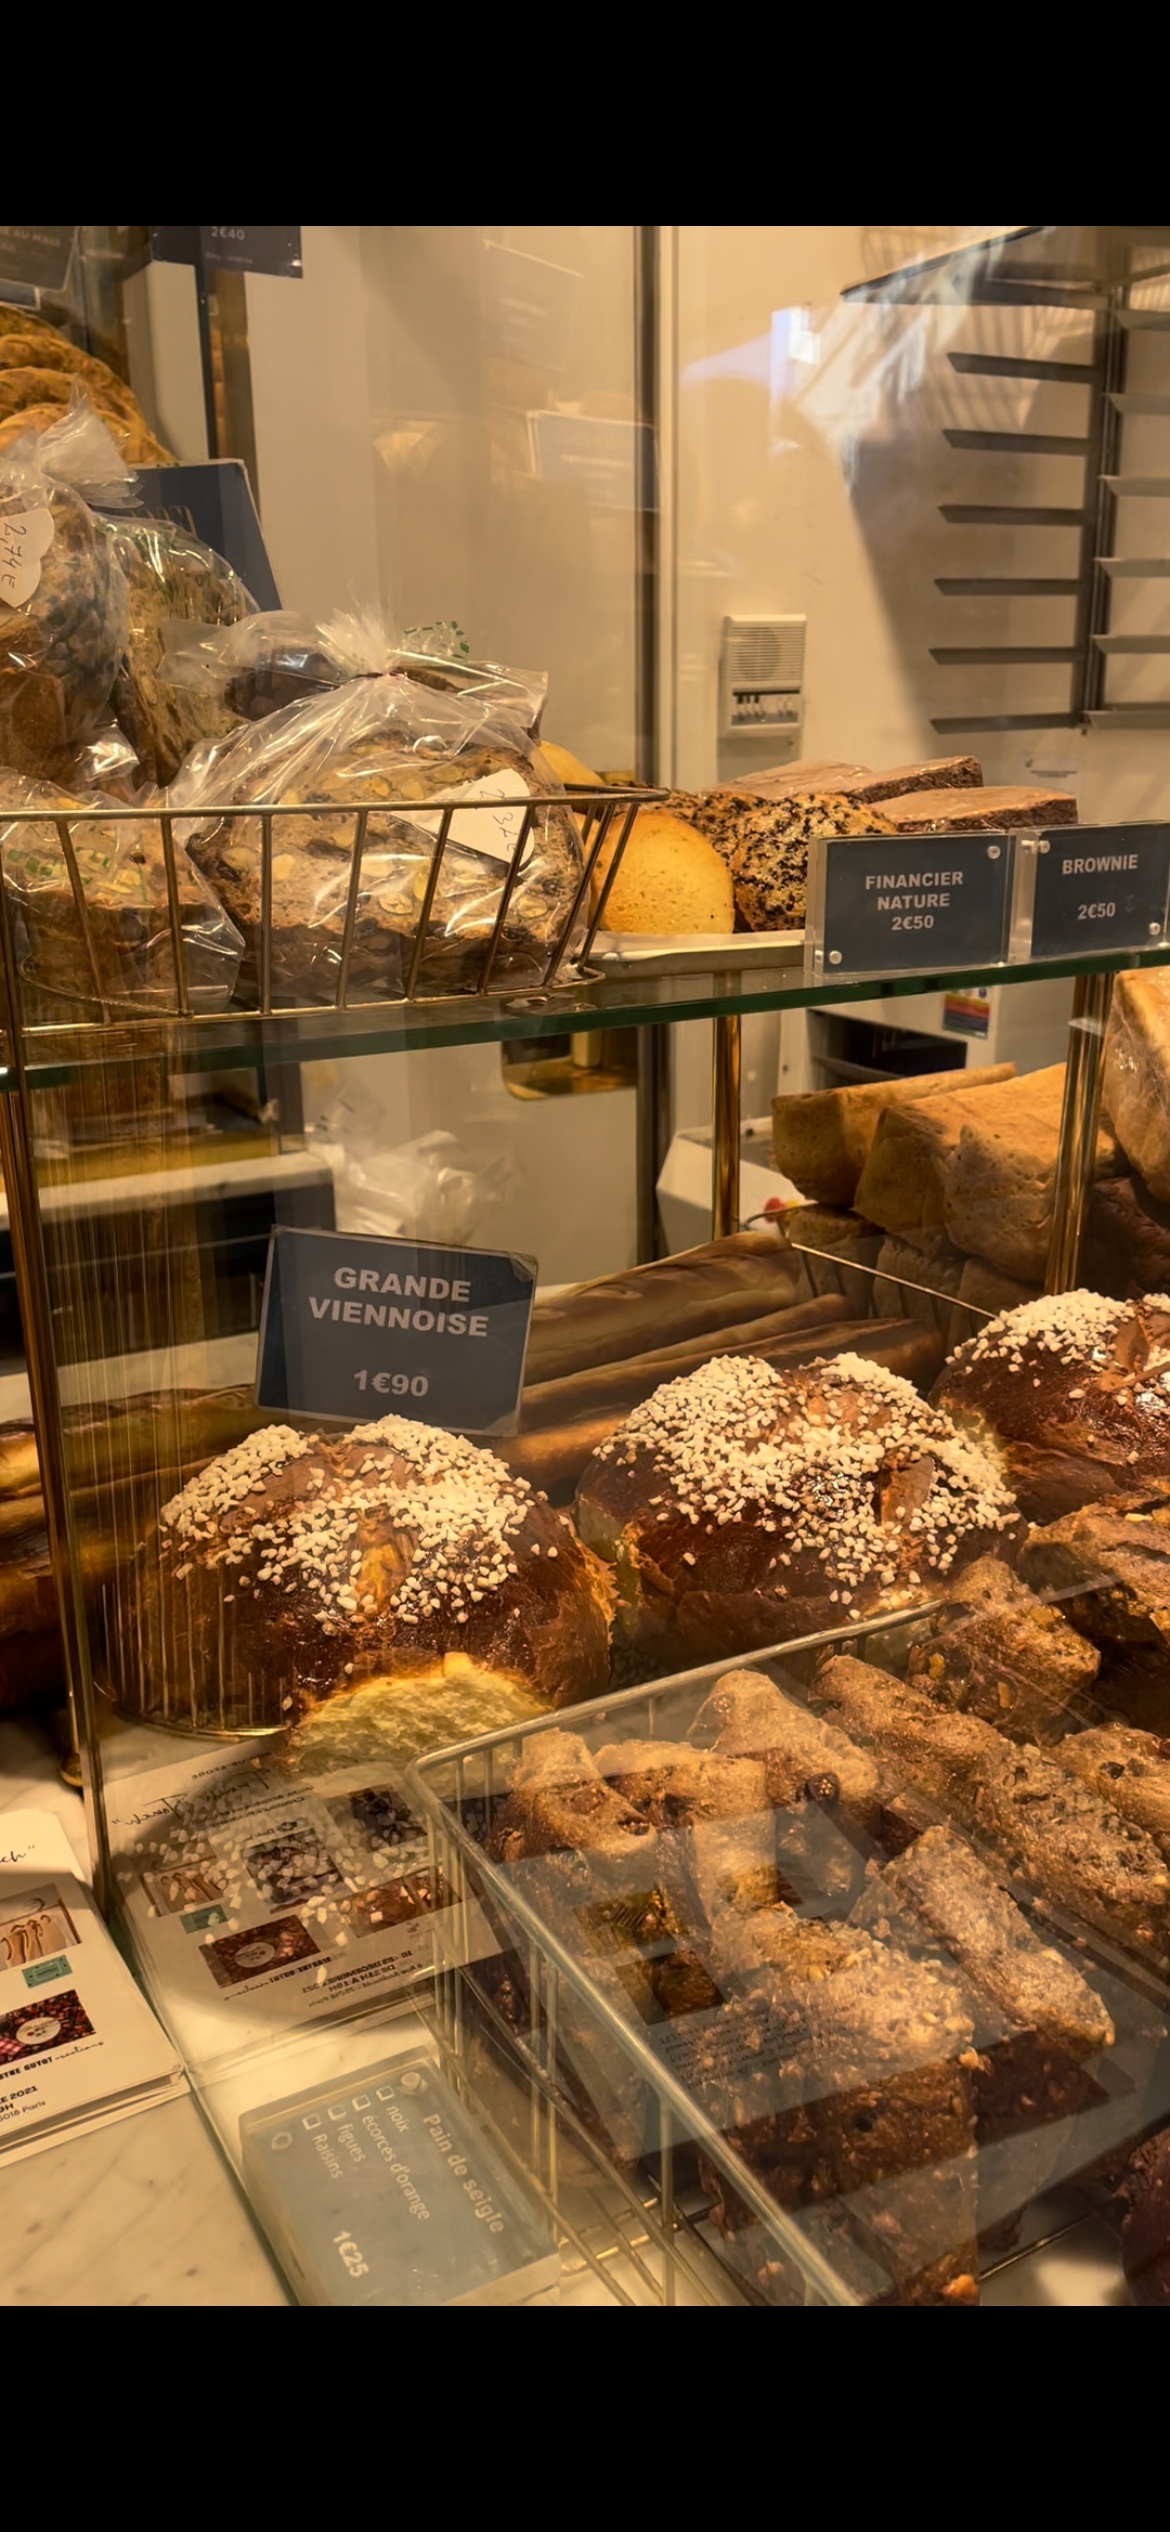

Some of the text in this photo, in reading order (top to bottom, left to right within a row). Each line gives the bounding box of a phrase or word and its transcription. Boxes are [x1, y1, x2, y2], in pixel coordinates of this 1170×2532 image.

[211, 226, 245, 240] 2€40
[1062, 854, 1138, 875] BROWNIE
[865, 871, 963, 890] FINANCIER
[877, 893, 950, 911] NATURE
[1077, 902, 1116, 920] 2€50
[891, 915, 934, 931] 2€50
[334, 1266, 471, 1302] GRANDE
[308, 1296, 489, 1337] VIENNOISE
[353, 1369, 429, 1397] 1€90
[9, 2085, 38, 2101] 2021
[22, 2100, 46, 2113] Paris
[386, 2105, 410, 2133] noix
[337, 2123, 366, 2163] figues
[311, 2132, 344, 2179] Raisins
[423, 2113, 504, 2233] Pain de seigle
[333, 2230, 370, 2278] 1€25
